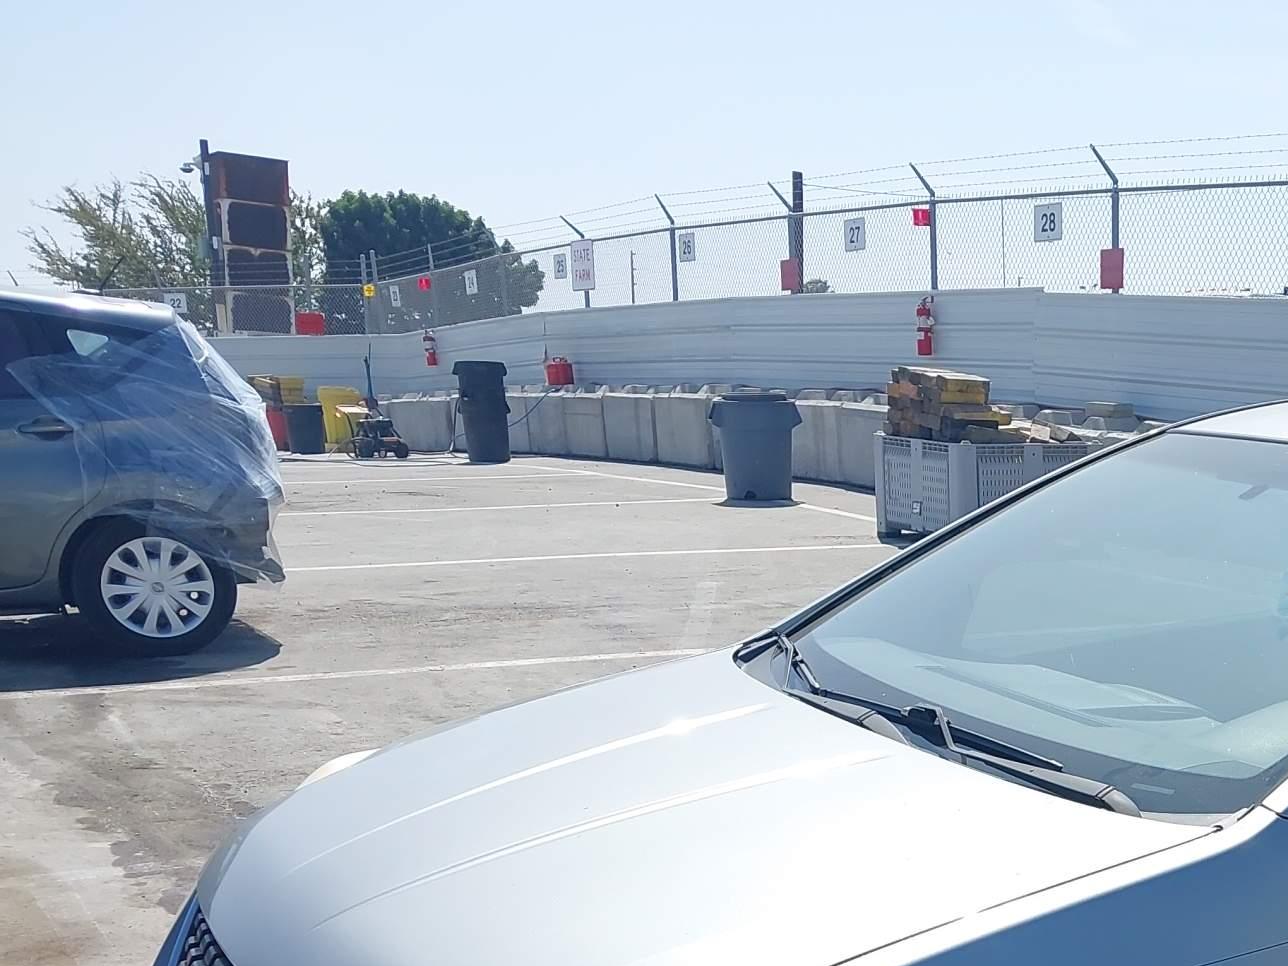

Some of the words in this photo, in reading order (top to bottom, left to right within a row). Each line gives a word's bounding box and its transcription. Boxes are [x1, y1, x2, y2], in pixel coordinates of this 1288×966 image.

[1041, 213, 1056, 232] 28
[849, 226, 860, 243] 27
[573, 248, 590, 262] STATE
[682, 240, 692, 256] 26
[556, 260, 565, 273] 25
[575, 271, 591, 282] FARM
[170, 298, 181, 308] 22
